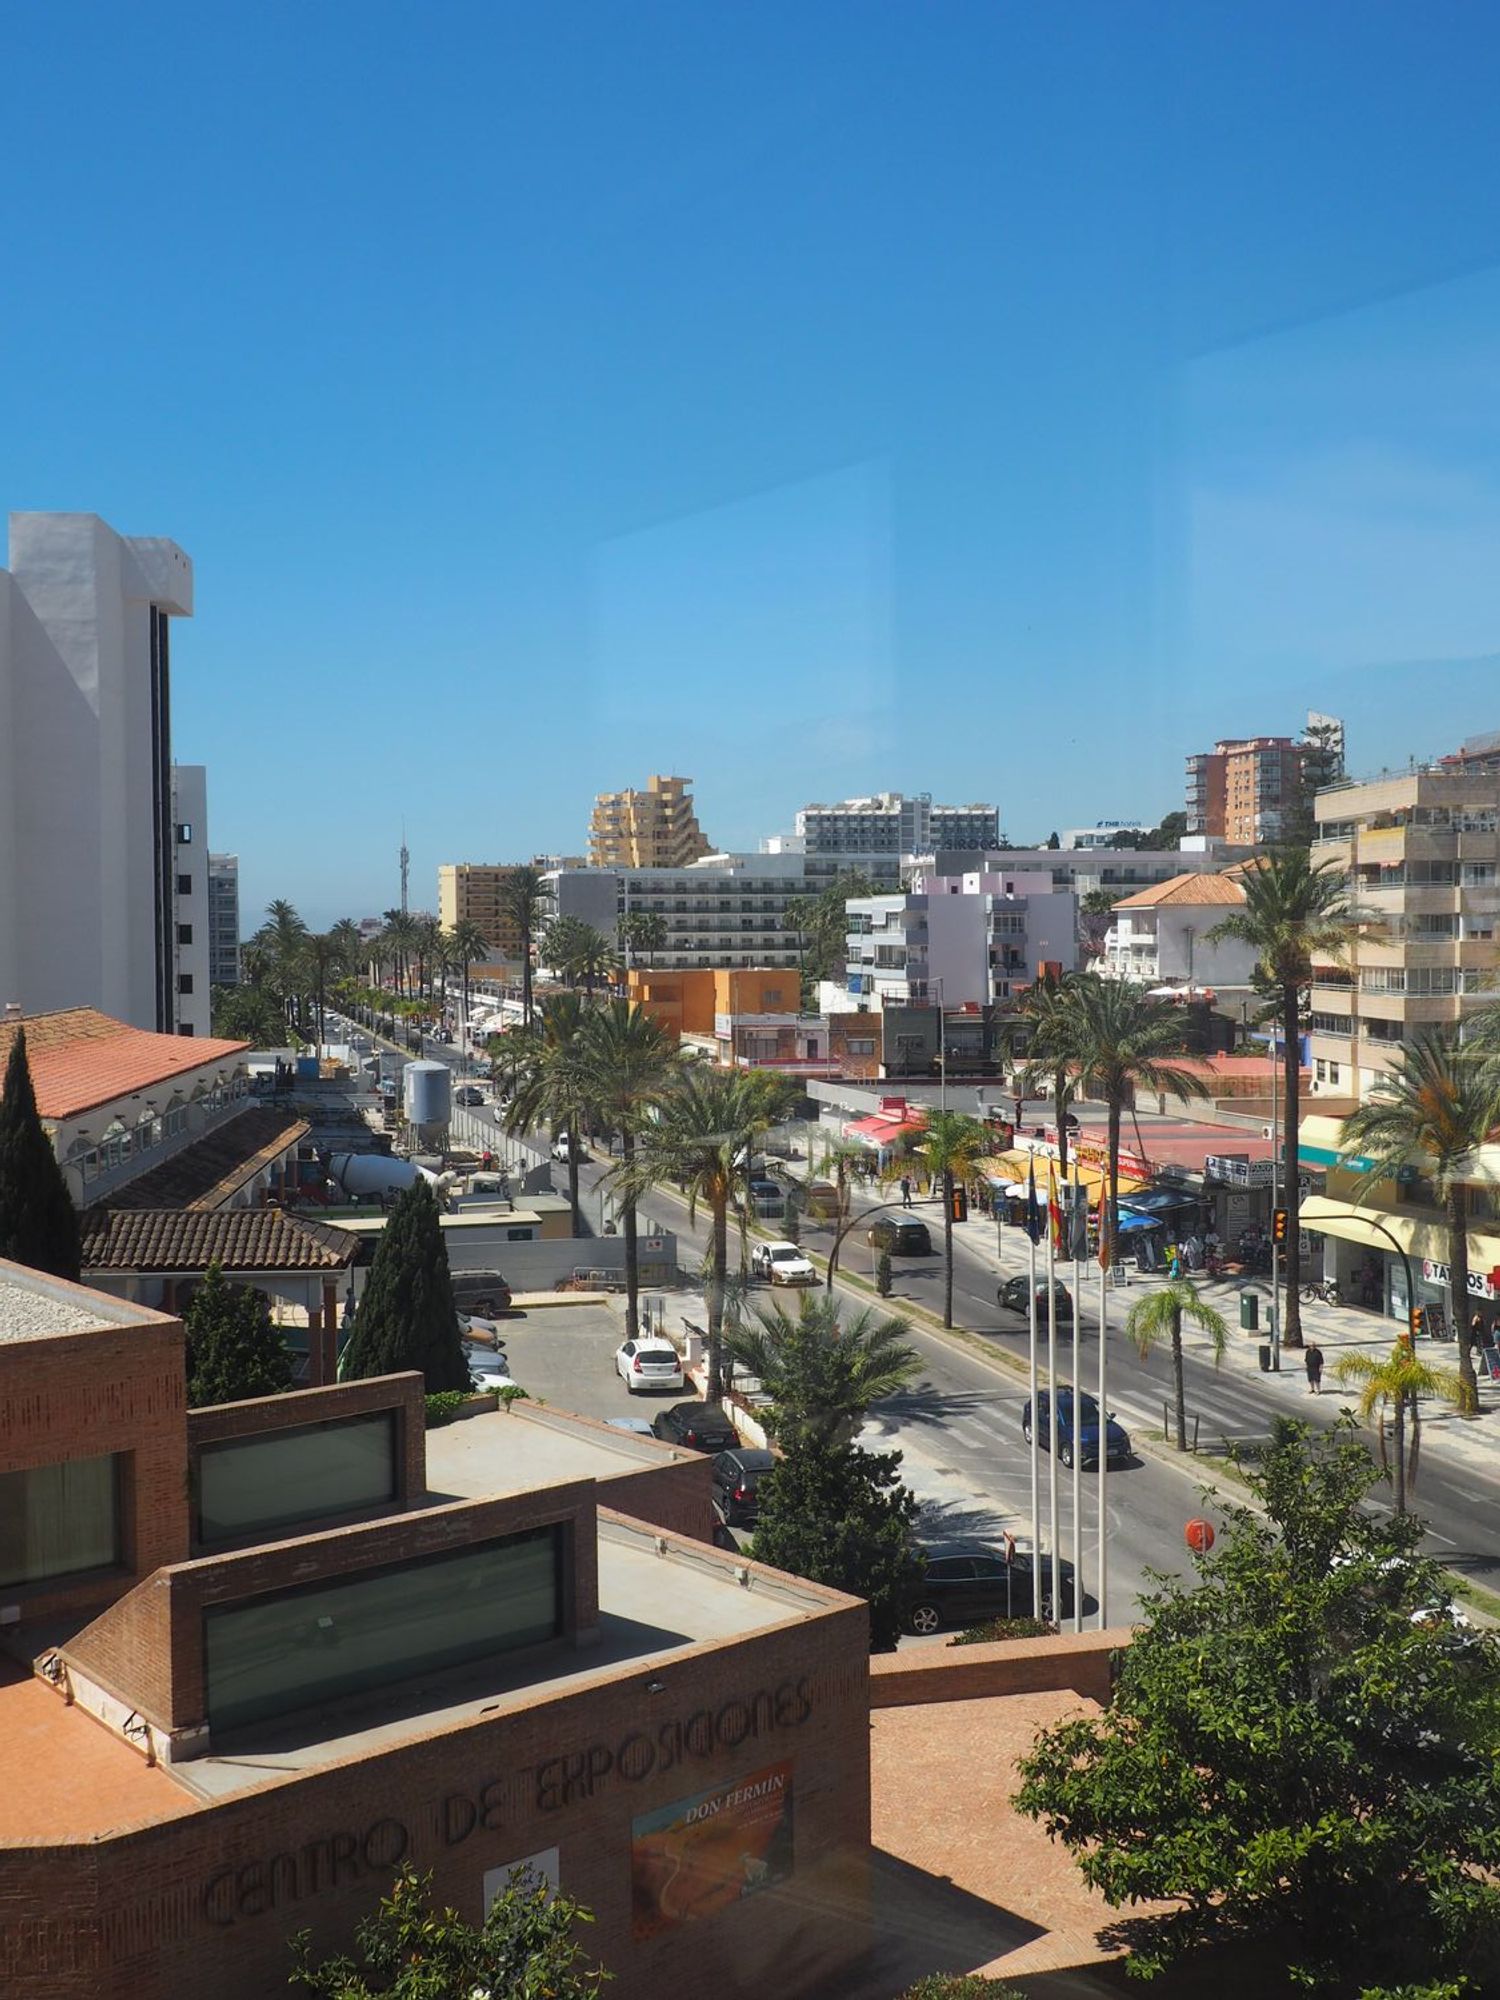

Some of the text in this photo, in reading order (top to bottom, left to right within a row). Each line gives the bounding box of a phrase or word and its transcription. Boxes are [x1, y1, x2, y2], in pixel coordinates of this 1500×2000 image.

[1432, 1263, 1483, 1290] TAOS
[200, 1674, 813, 1926] CENTRO DE EXPOSICIONES
[685, 1797, 722, 1825] DON
[725, 1773, 785, 1809] FERMÍN
